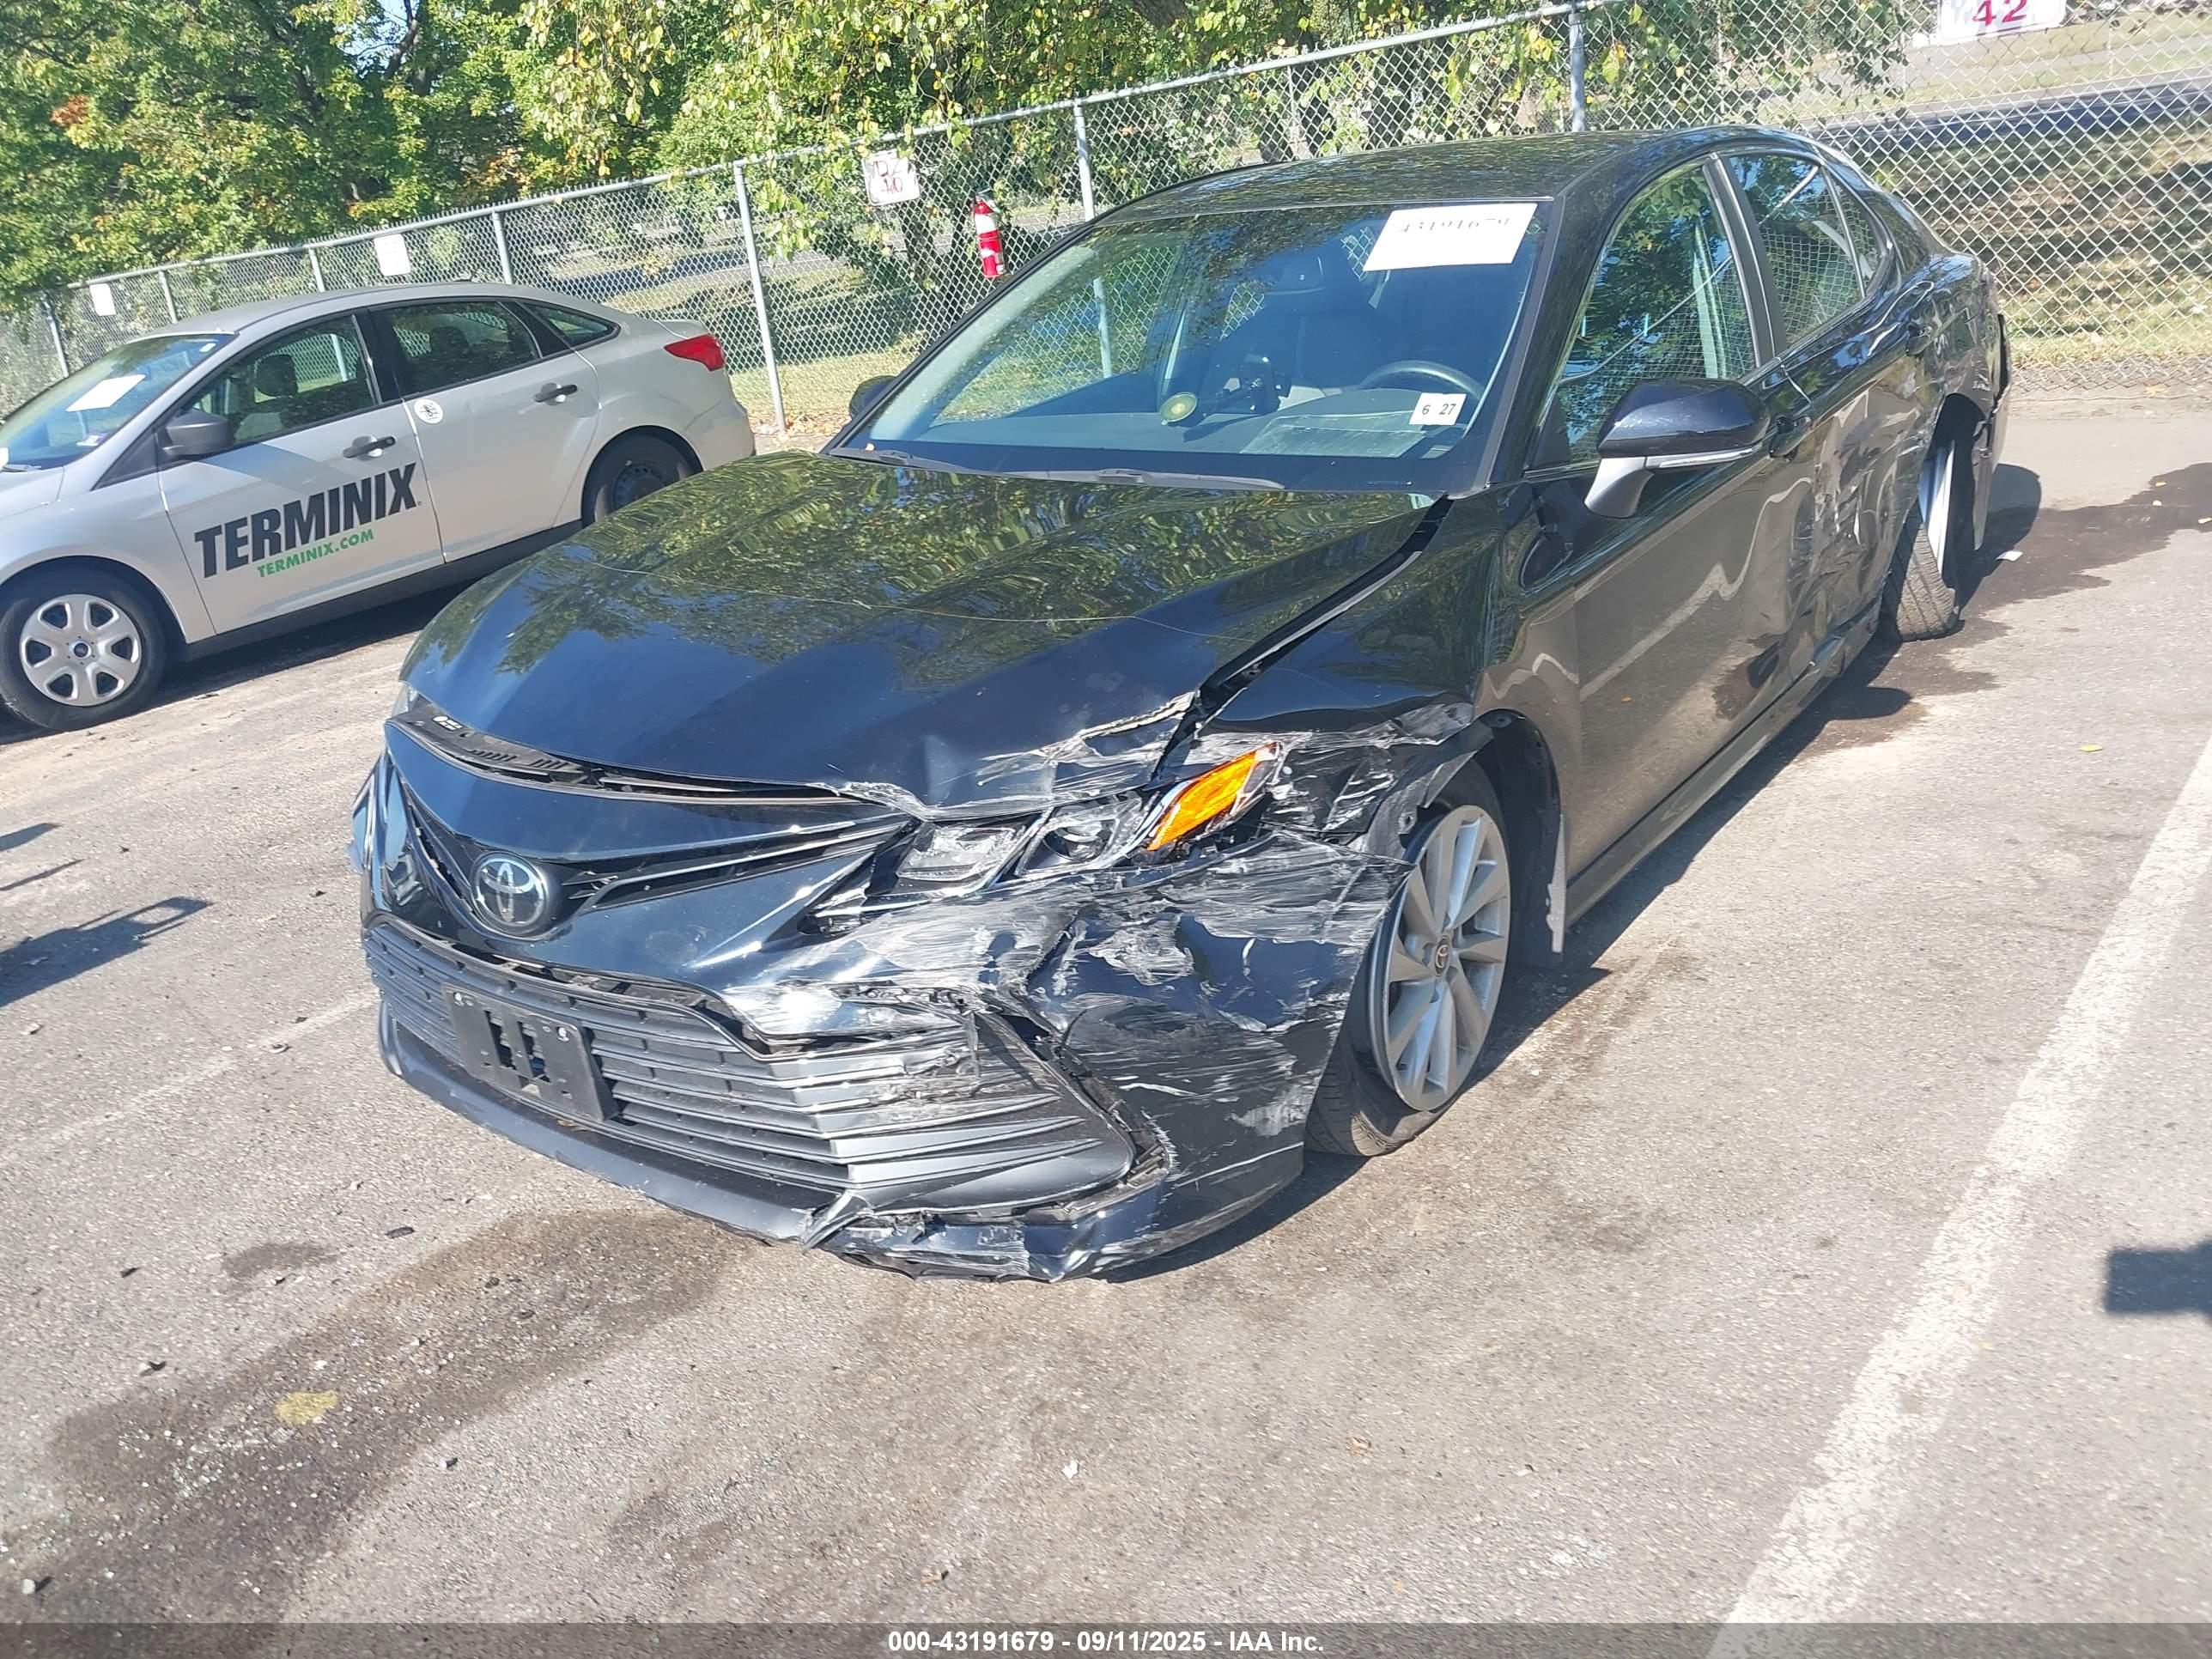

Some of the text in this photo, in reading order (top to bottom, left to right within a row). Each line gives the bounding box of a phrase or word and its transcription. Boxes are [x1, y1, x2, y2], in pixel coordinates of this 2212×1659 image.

[1972, 0, 2027, 27] 42
[1421, 403, 1457, 416] 6 27
[195, 462, 417, 578] TERMINIX
[257, 529, 374, 578] TERMINIX.COM
